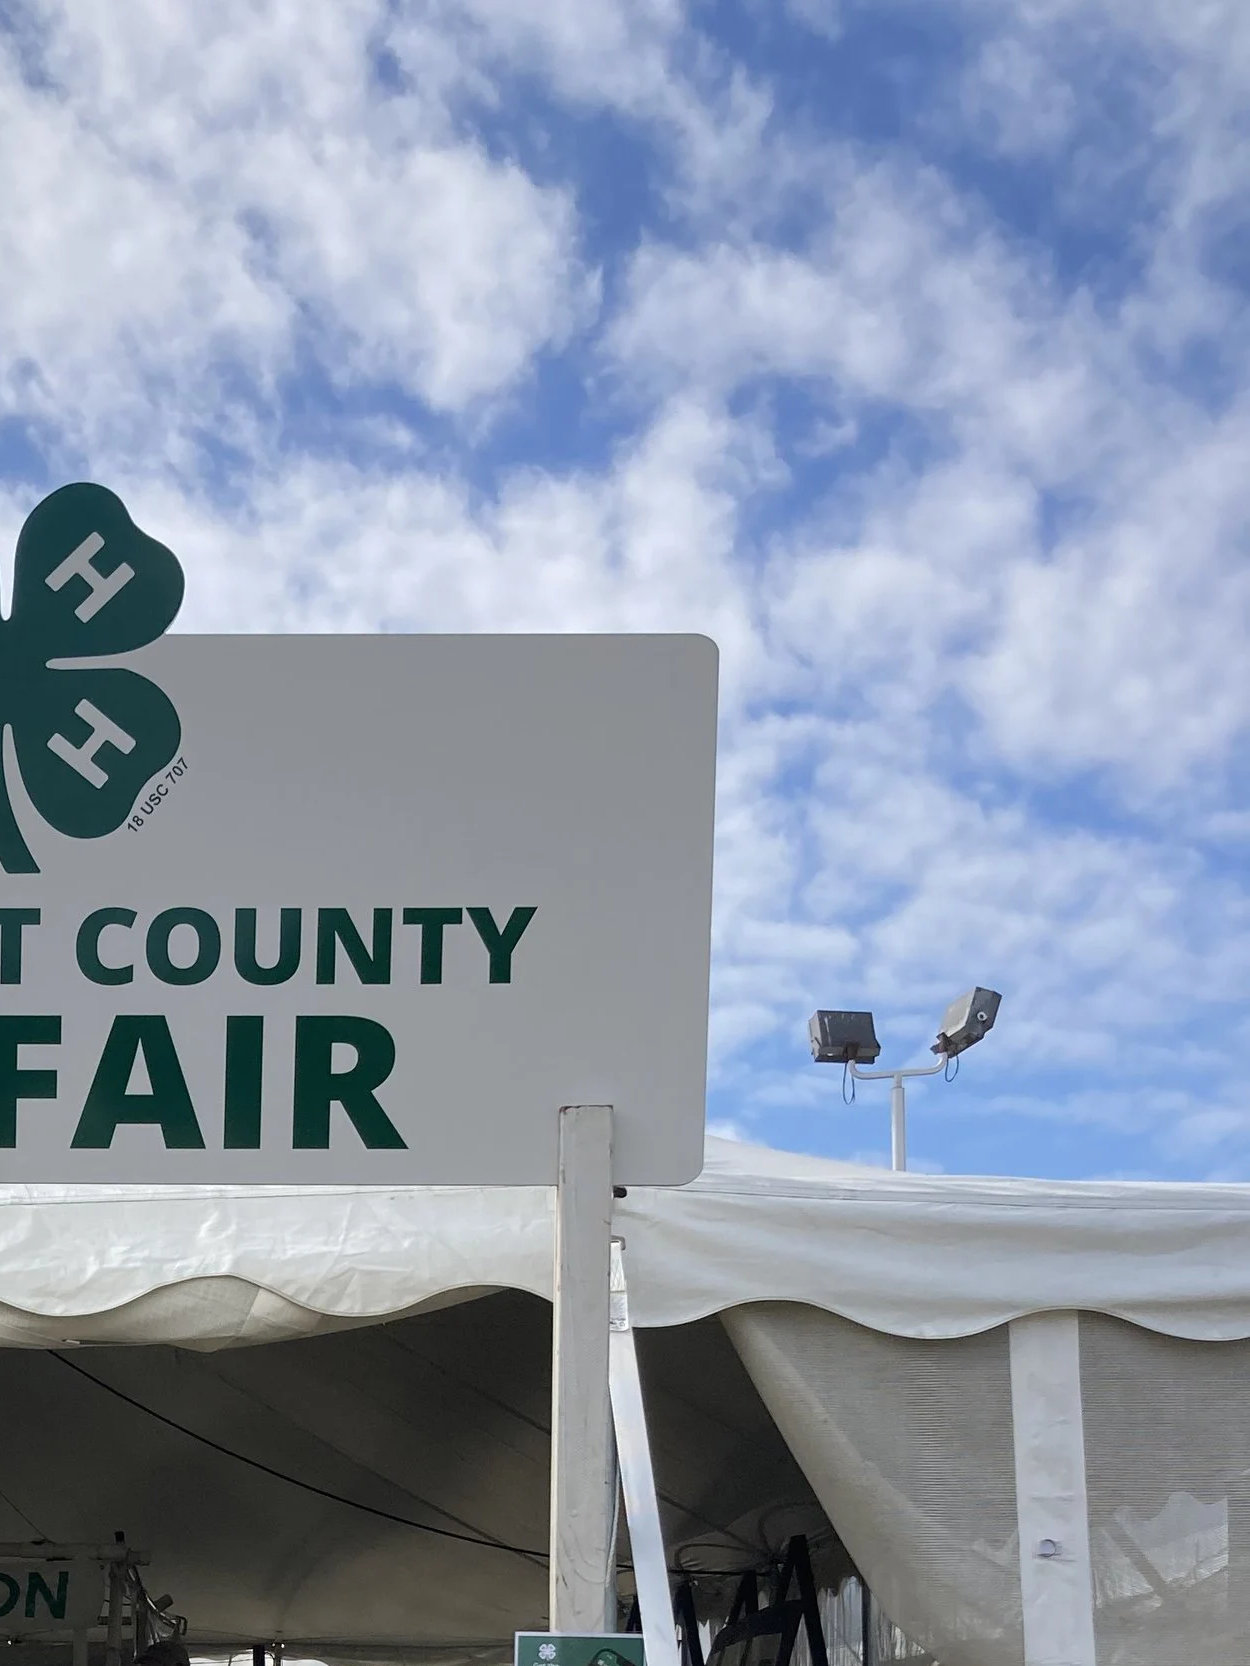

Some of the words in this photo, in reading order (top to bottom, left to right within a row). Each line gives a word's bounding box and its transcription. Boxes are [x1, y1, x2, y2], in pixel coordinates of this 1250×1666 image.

[44, 530, 136, 624] H
[46, 698, 137, 790] H
[127, 815, 144, 832] 18
[140, 784, 169, 815] USC
[165, 757, 188, 784] 707
[75, 905, 538, 986] COUNTY
